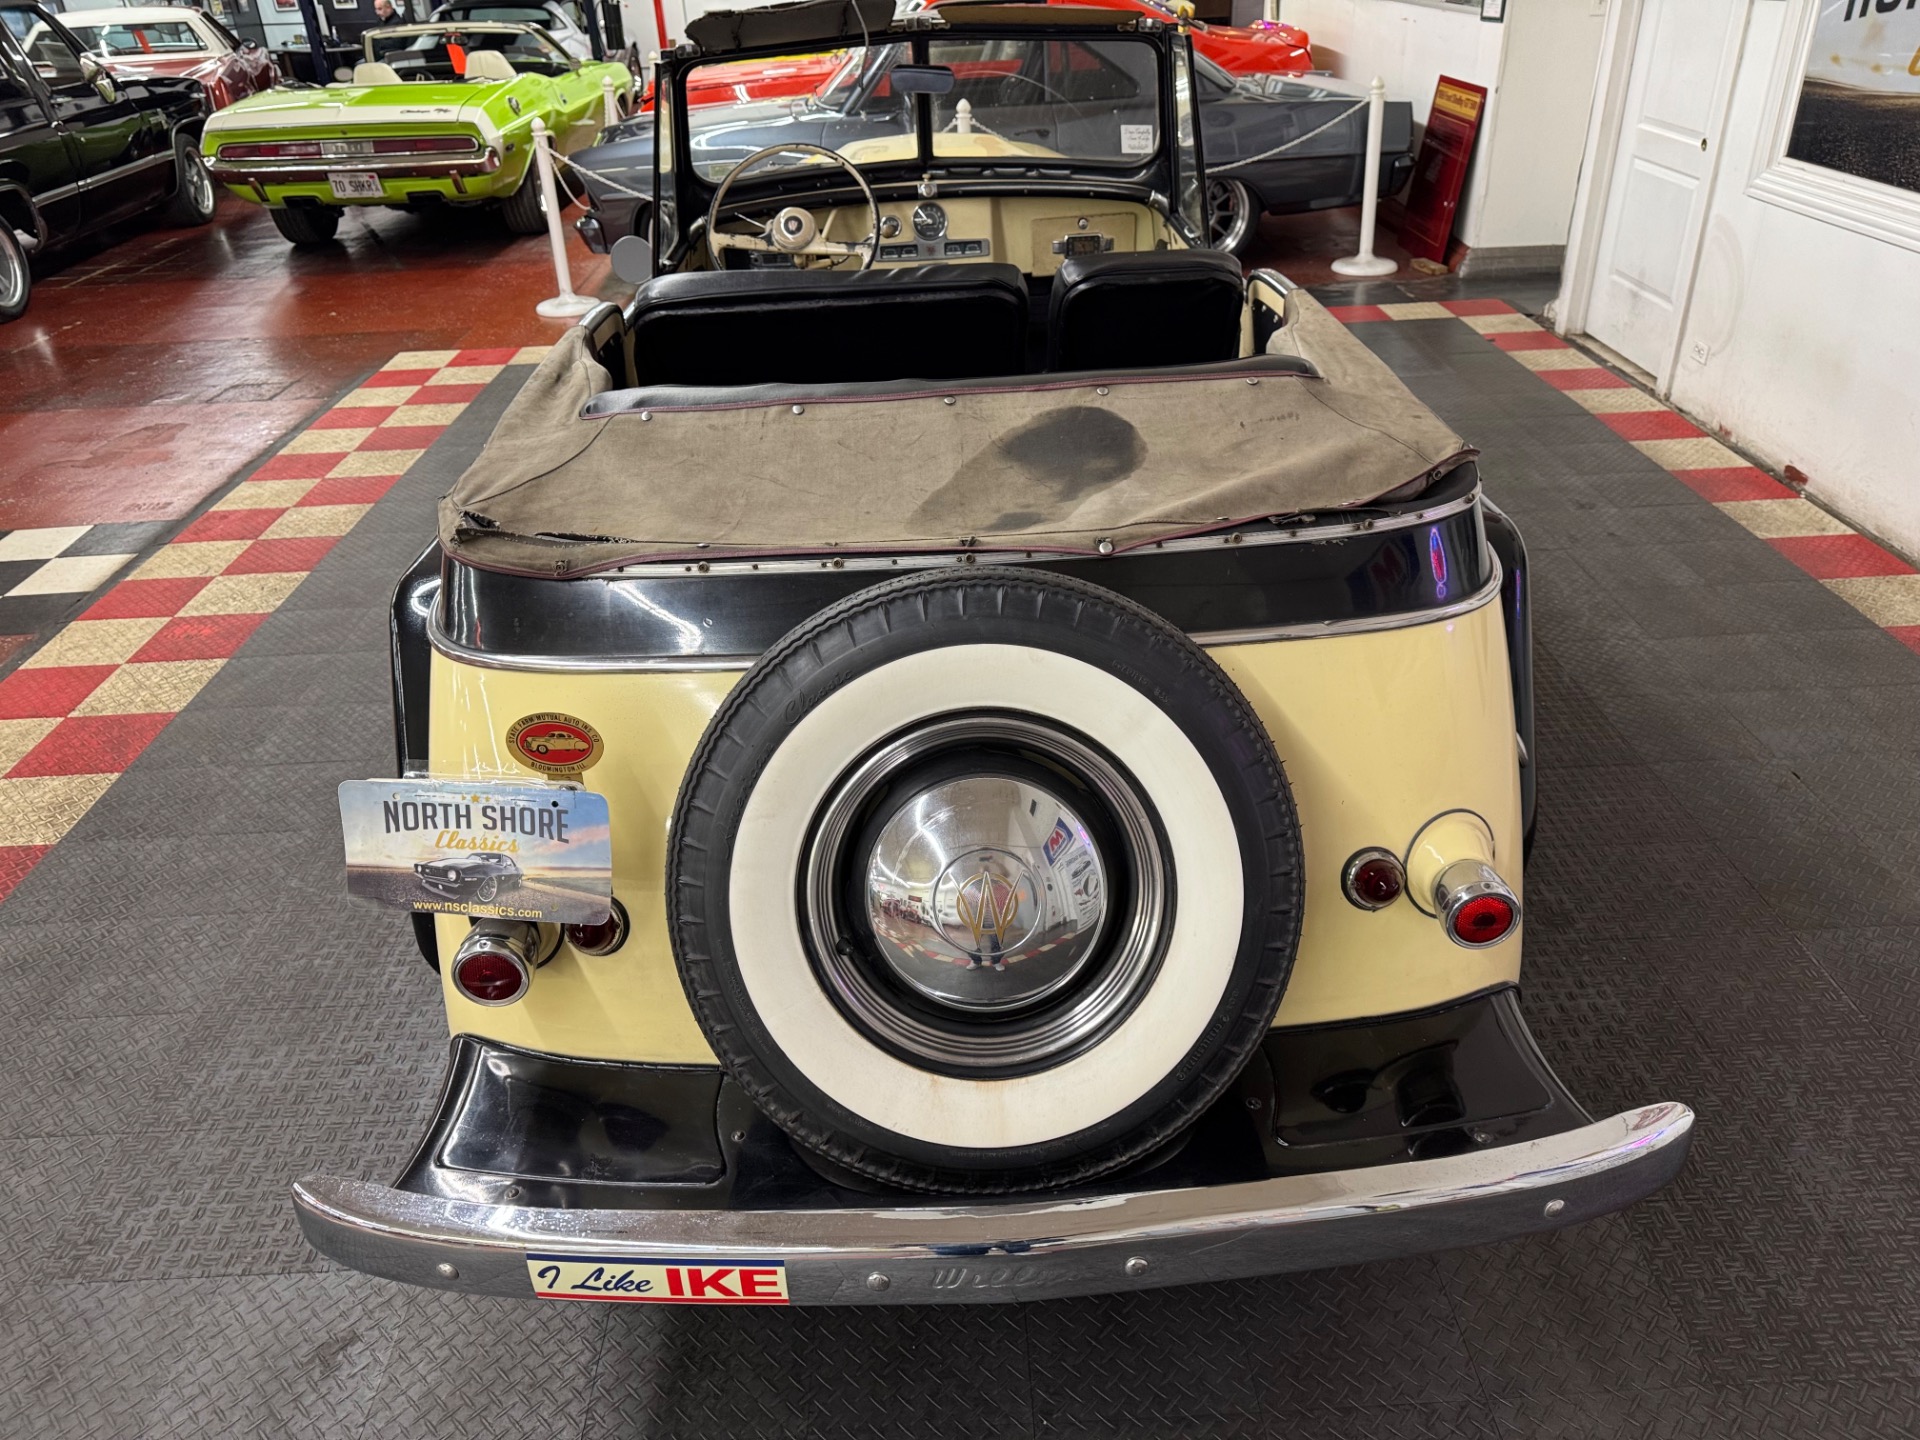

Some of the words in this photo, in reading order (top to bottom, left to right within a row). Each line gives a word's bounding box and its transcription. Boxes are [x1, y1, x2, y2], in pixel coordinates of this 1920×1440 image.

[333, 180, 346, 193] 70
[349, 180, 374, 193] SHKR
[784, 670, 854, 726] Classic
[508, 727, 519, 744] STATE
[518, 716, 534, 728] FARM
[535, 714, 562, 722] MUTUAL
[564, 716, 580, 727] AUTO
[383, 800, 472, 834] NORTH
[481, 804, 570, 844] SHORE
[434, 828, 520, 853] Classics
[413, 900, 543, 919] www.nsclassics.com
[536, 1265, 561, 1289] I
[570, 1266, 654, 1293] Like
[665, 1268, 783, 1298] IKE
